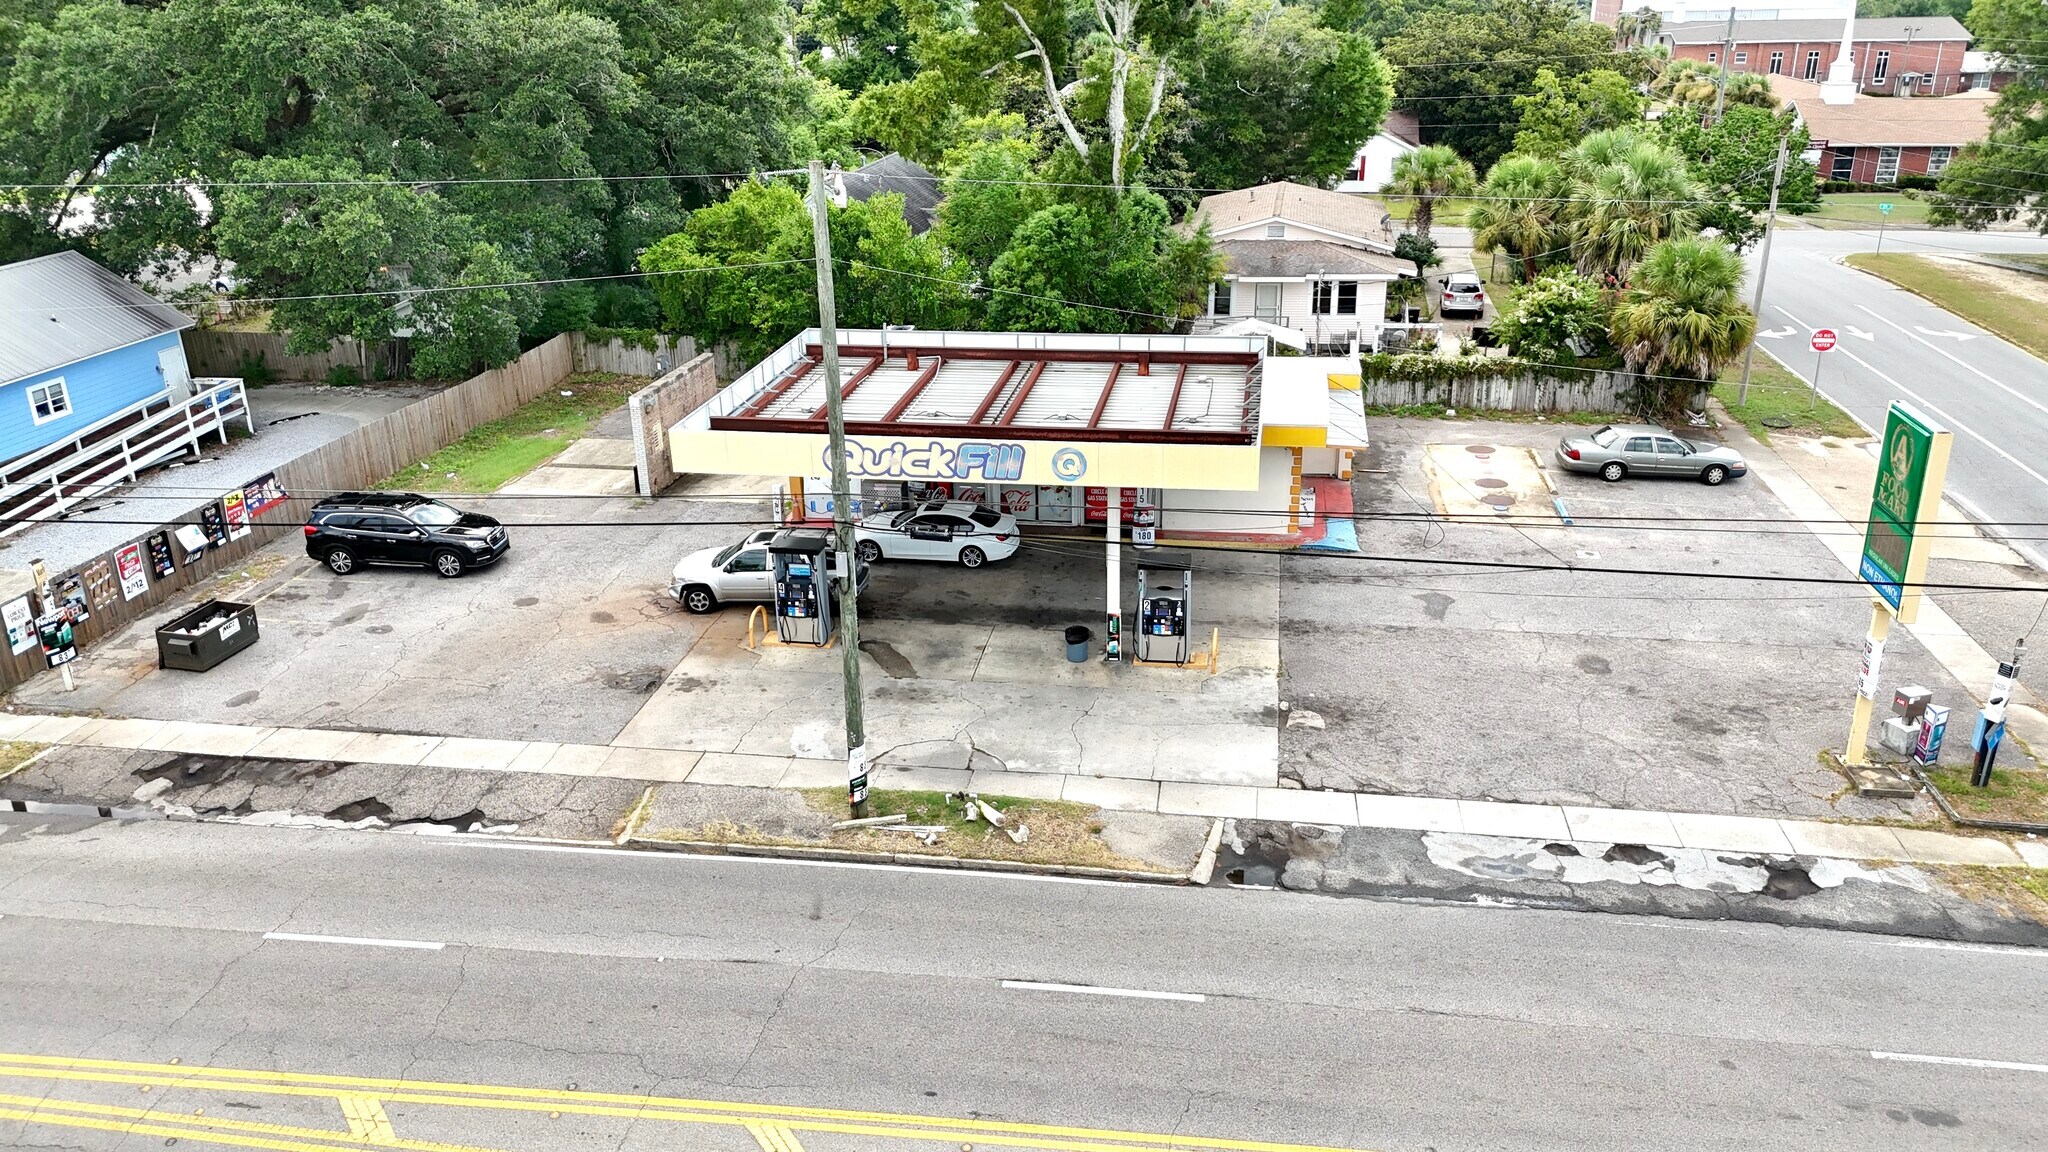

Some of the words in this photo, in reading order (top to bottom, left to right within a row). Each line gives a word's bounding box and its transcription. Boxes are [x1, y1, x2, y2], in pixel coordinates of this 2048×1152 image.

[1877, 485, 1907, 521] MART
[1880, 470, 1909, 505] FOOD
[1137, 531, 1152, 540] 180
[1861, 559, 1875, 578] NON
[1873, 570, 1899, 603] ETHANOL
[1868, 548, 1884, 566] REGULAR
[1882, 562, 1900, 581] UNLEADED
